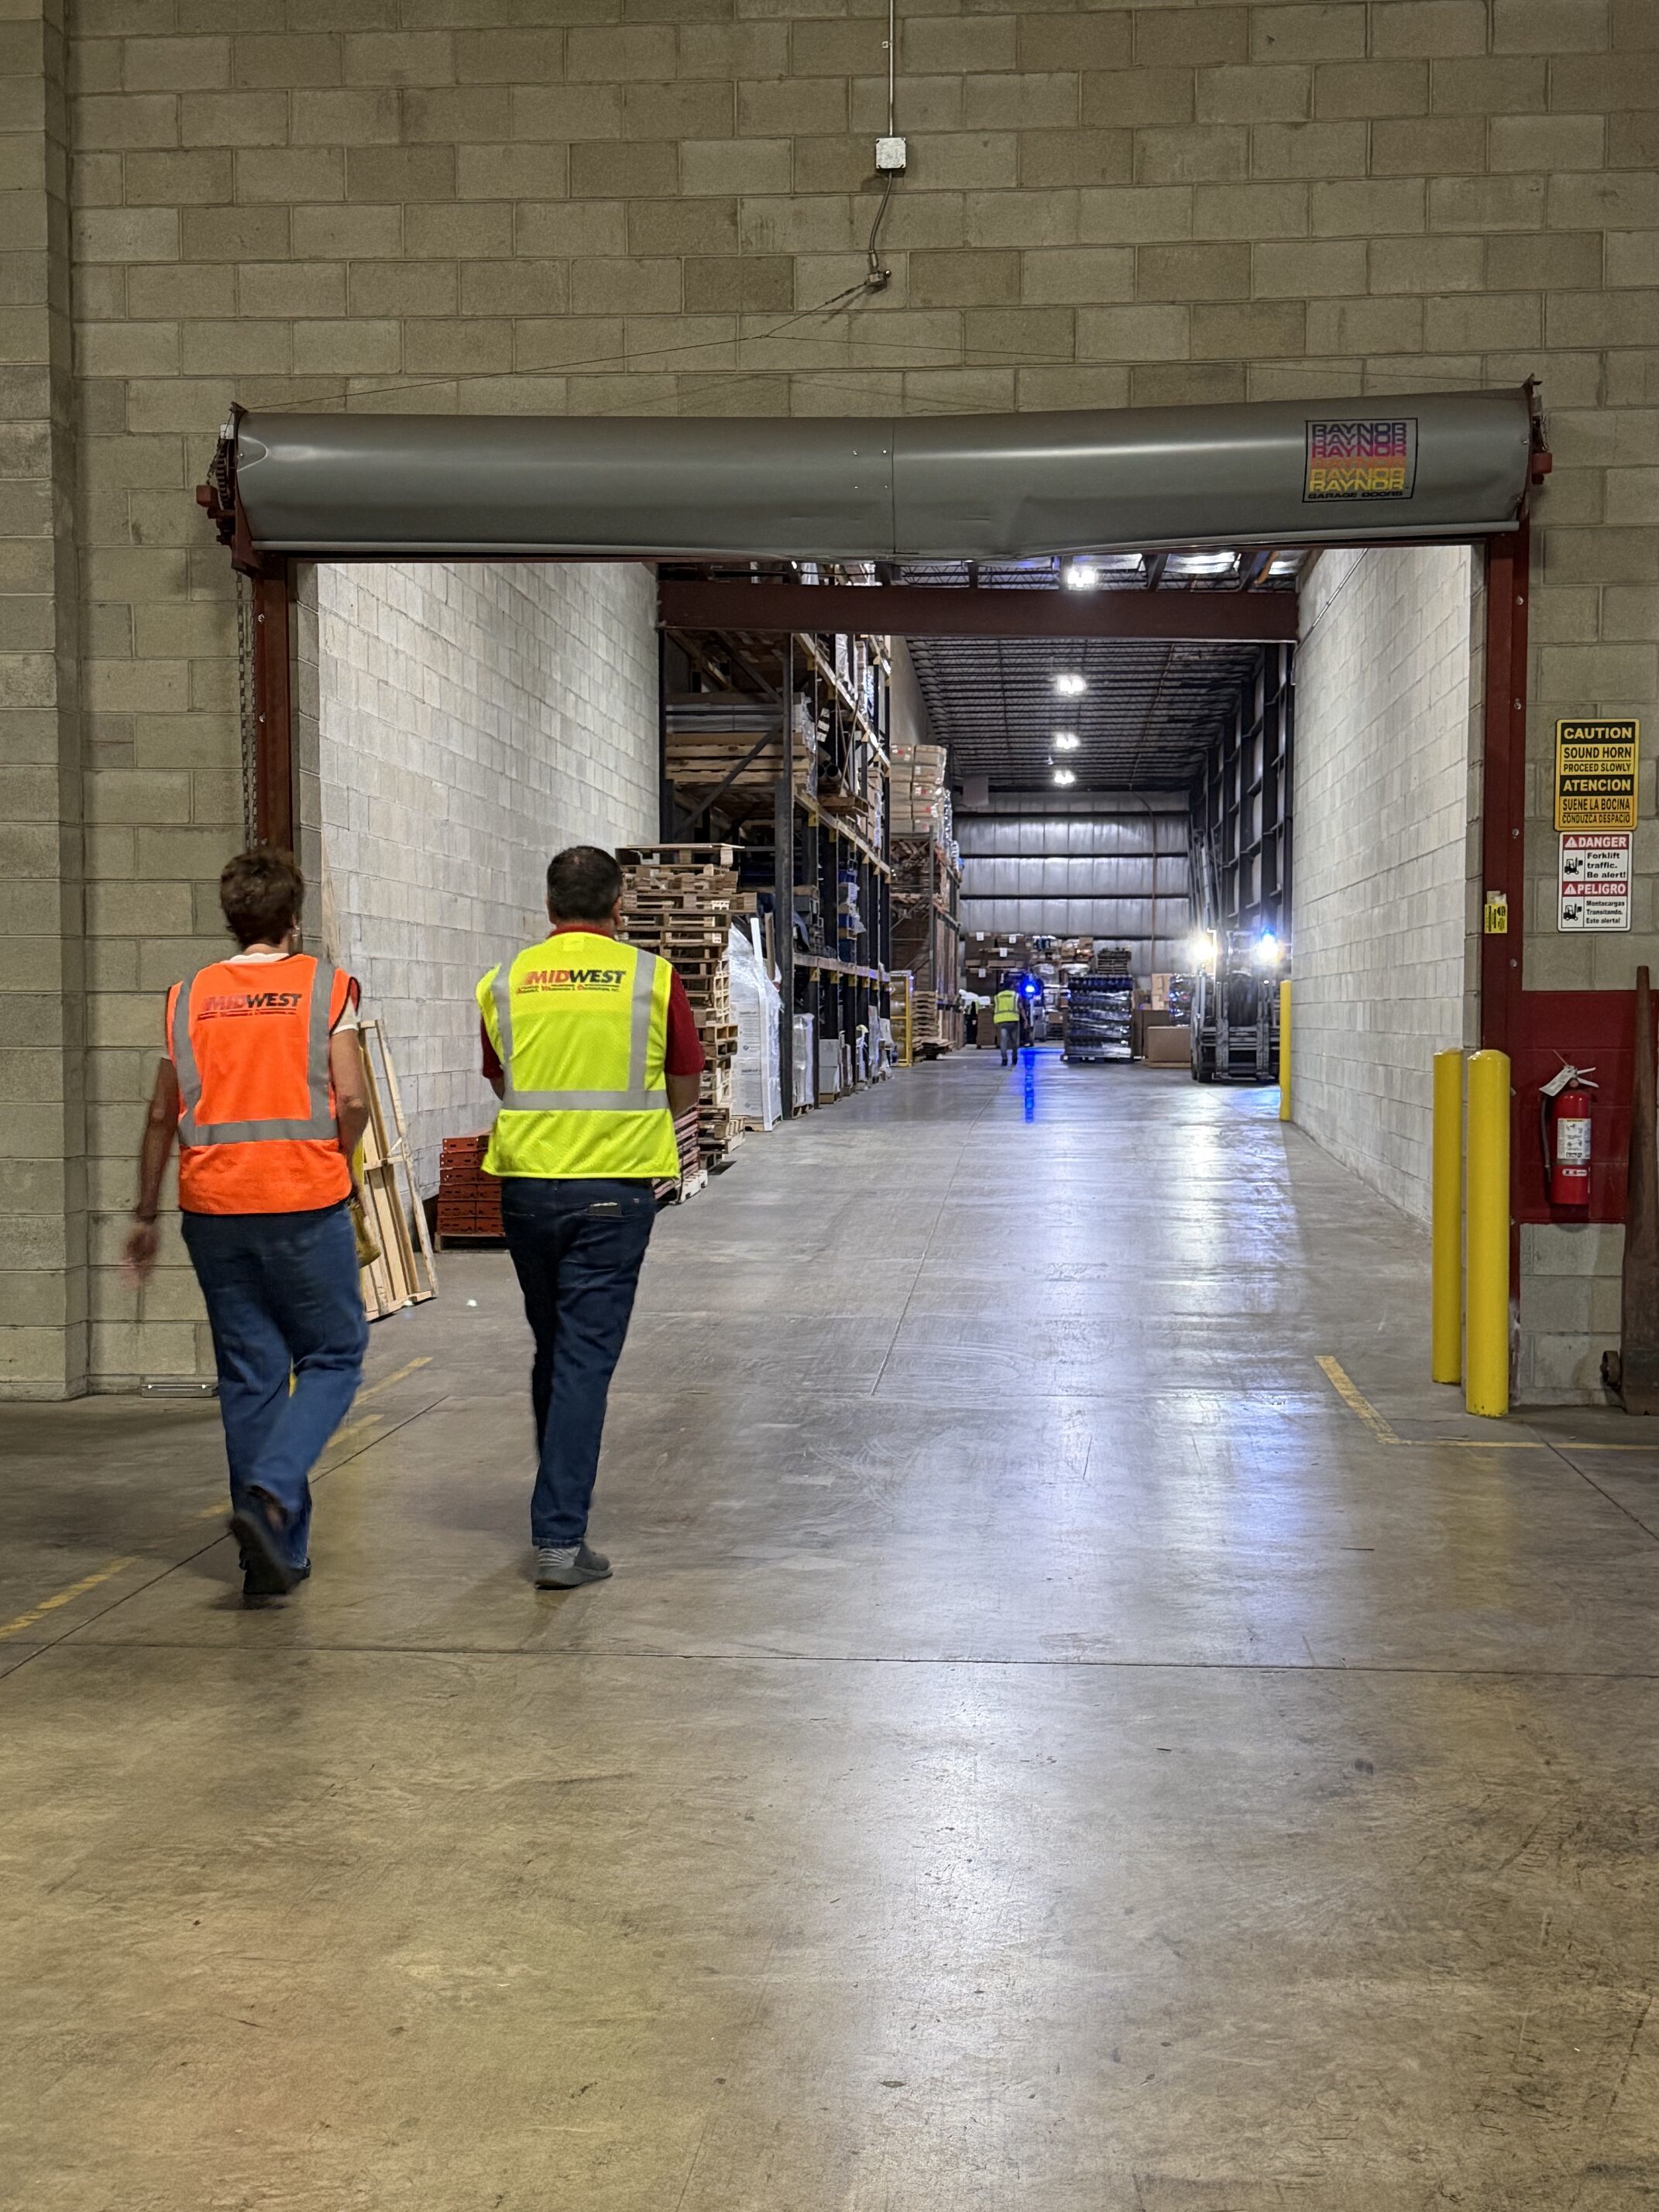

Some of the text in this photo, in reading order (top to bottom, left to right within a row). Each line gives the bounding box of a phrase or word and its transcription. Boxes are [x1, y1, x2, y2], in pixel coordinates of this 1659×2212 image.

[1309, 479, 1404, 492] RAYNOR
[1564, 727, 1633, 740] CAUTION
[1564, 747, 1631, 759] SOUND HORN
[1564, 763, 1631, 773] PROCEED SLOWLY
[1563, 779, 1631, 792] ATENCION
[1563, 799, 1630, 811] SUENE LA BOCINA
[1562, 813, 1630, 824] CONDUZCA DESPACIO
[1578, 836, 1626, 848] DANGER
[1577, 883, 1626, 895] PELIGRO
[524, 970, 627, 984] MIDWEST
[203, 993, 303, 1011] MIDWEST
